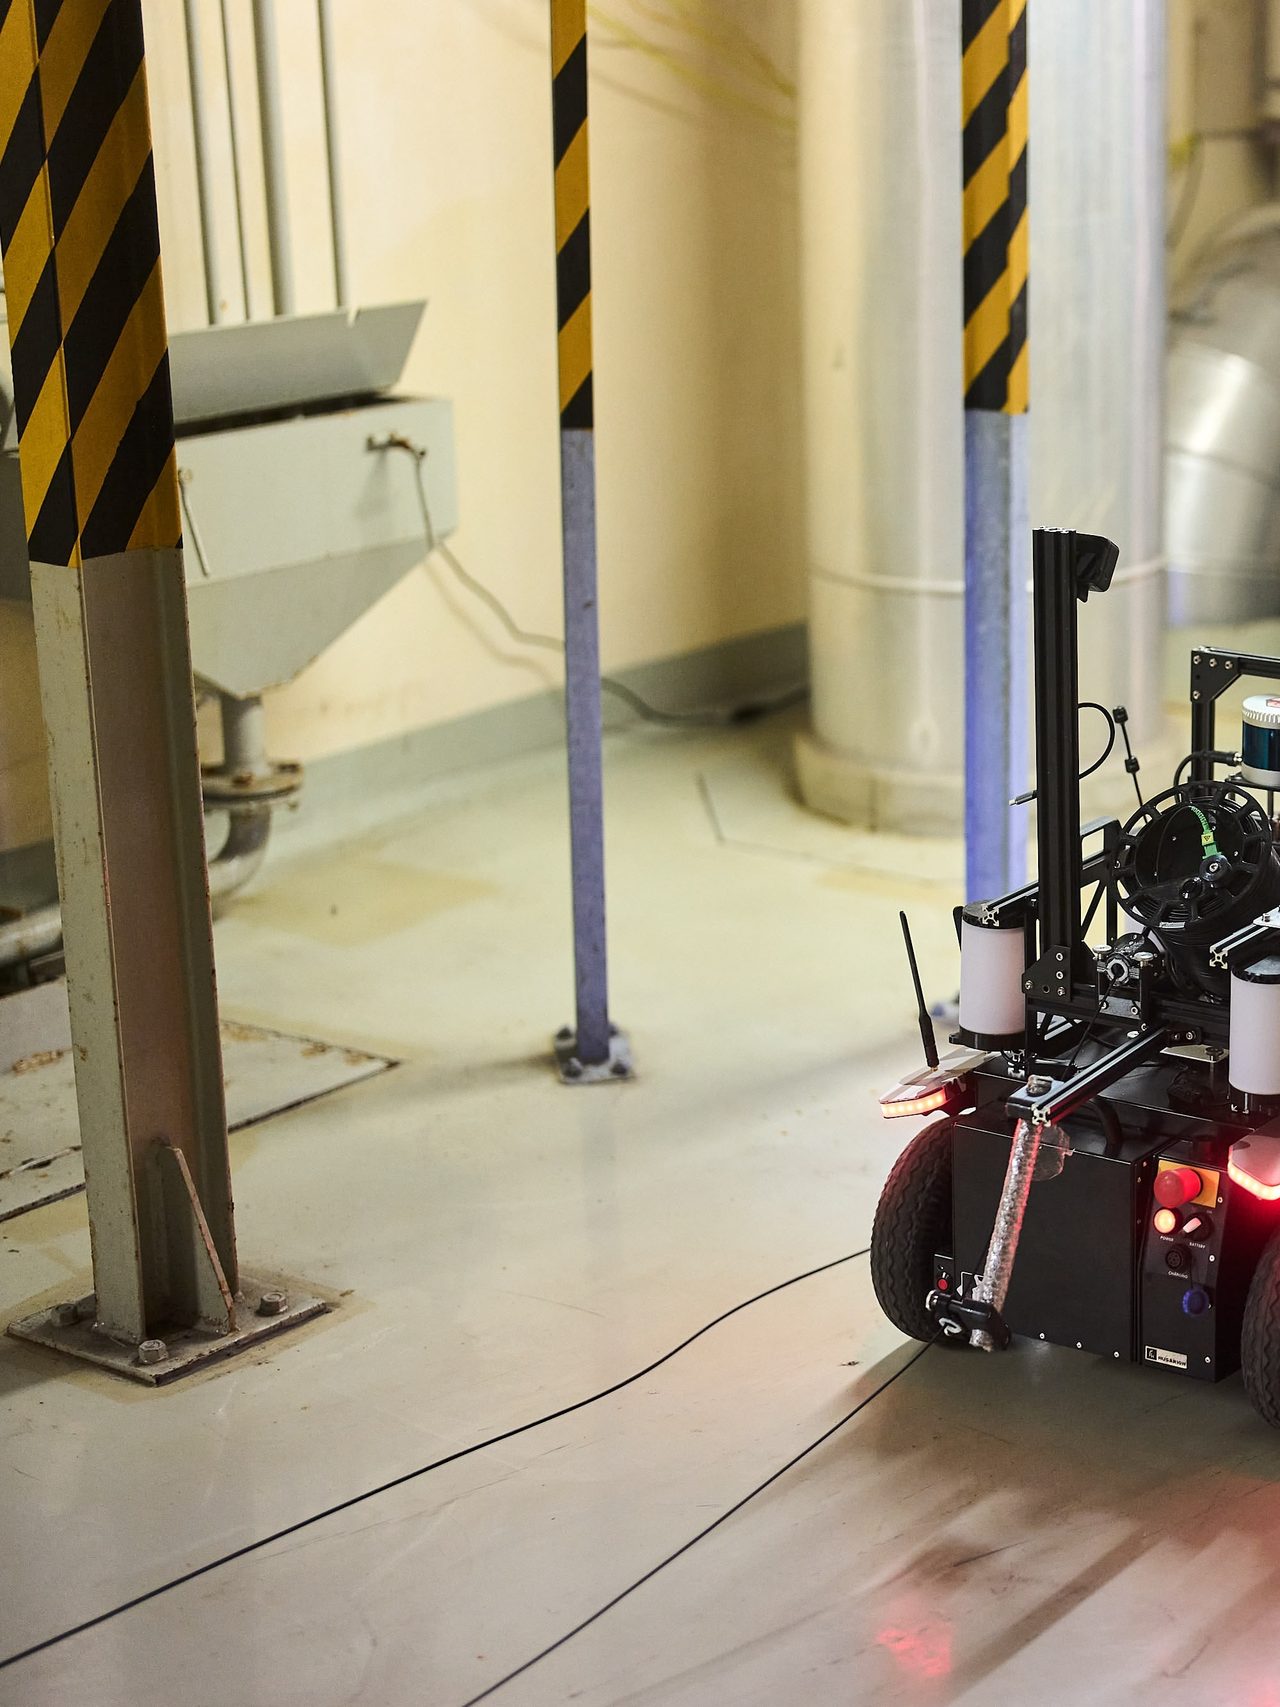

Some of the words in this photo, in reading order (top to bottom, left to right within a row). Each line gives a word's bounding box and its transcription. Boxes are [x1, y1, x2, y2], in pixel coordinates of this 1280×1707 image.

[1189, 1241, 1206, 1249] BATTERY
[1168, 1270, 1188, 1279] CHARGING
[1158, 1356, 1187, 1366] HUSARION
